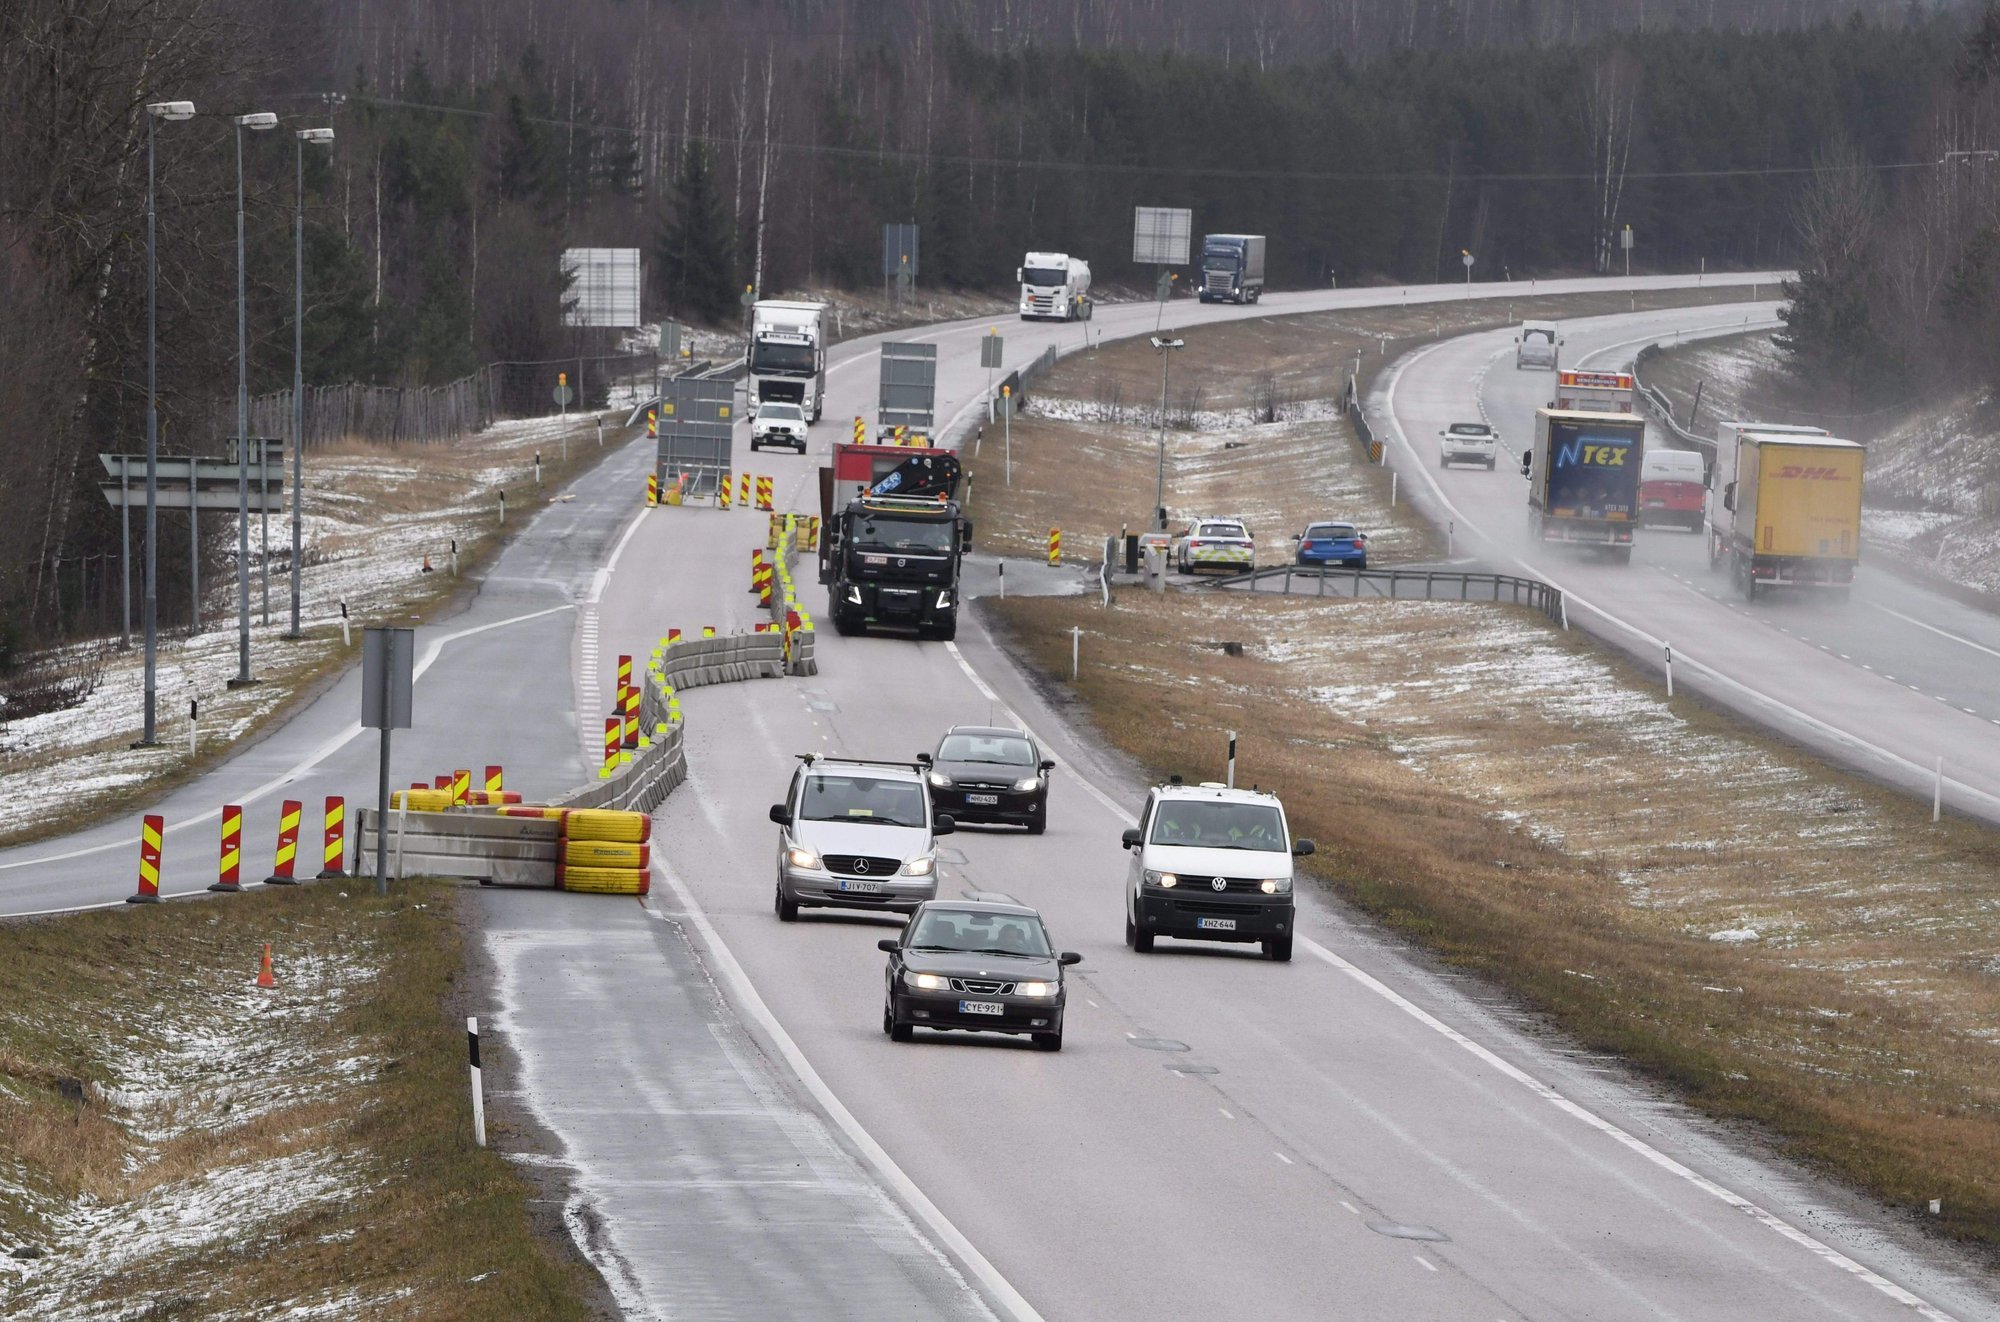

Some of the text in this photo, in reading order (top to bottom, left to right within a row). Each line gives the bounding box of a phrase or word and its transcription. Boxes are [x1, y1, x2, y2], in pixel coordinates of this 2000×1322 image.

[1780, 465, 1838, 480] DHL
[1204, 920, 1234, 928] XHZ-644
[966, 1003, 1000, 1014] CYE-921
